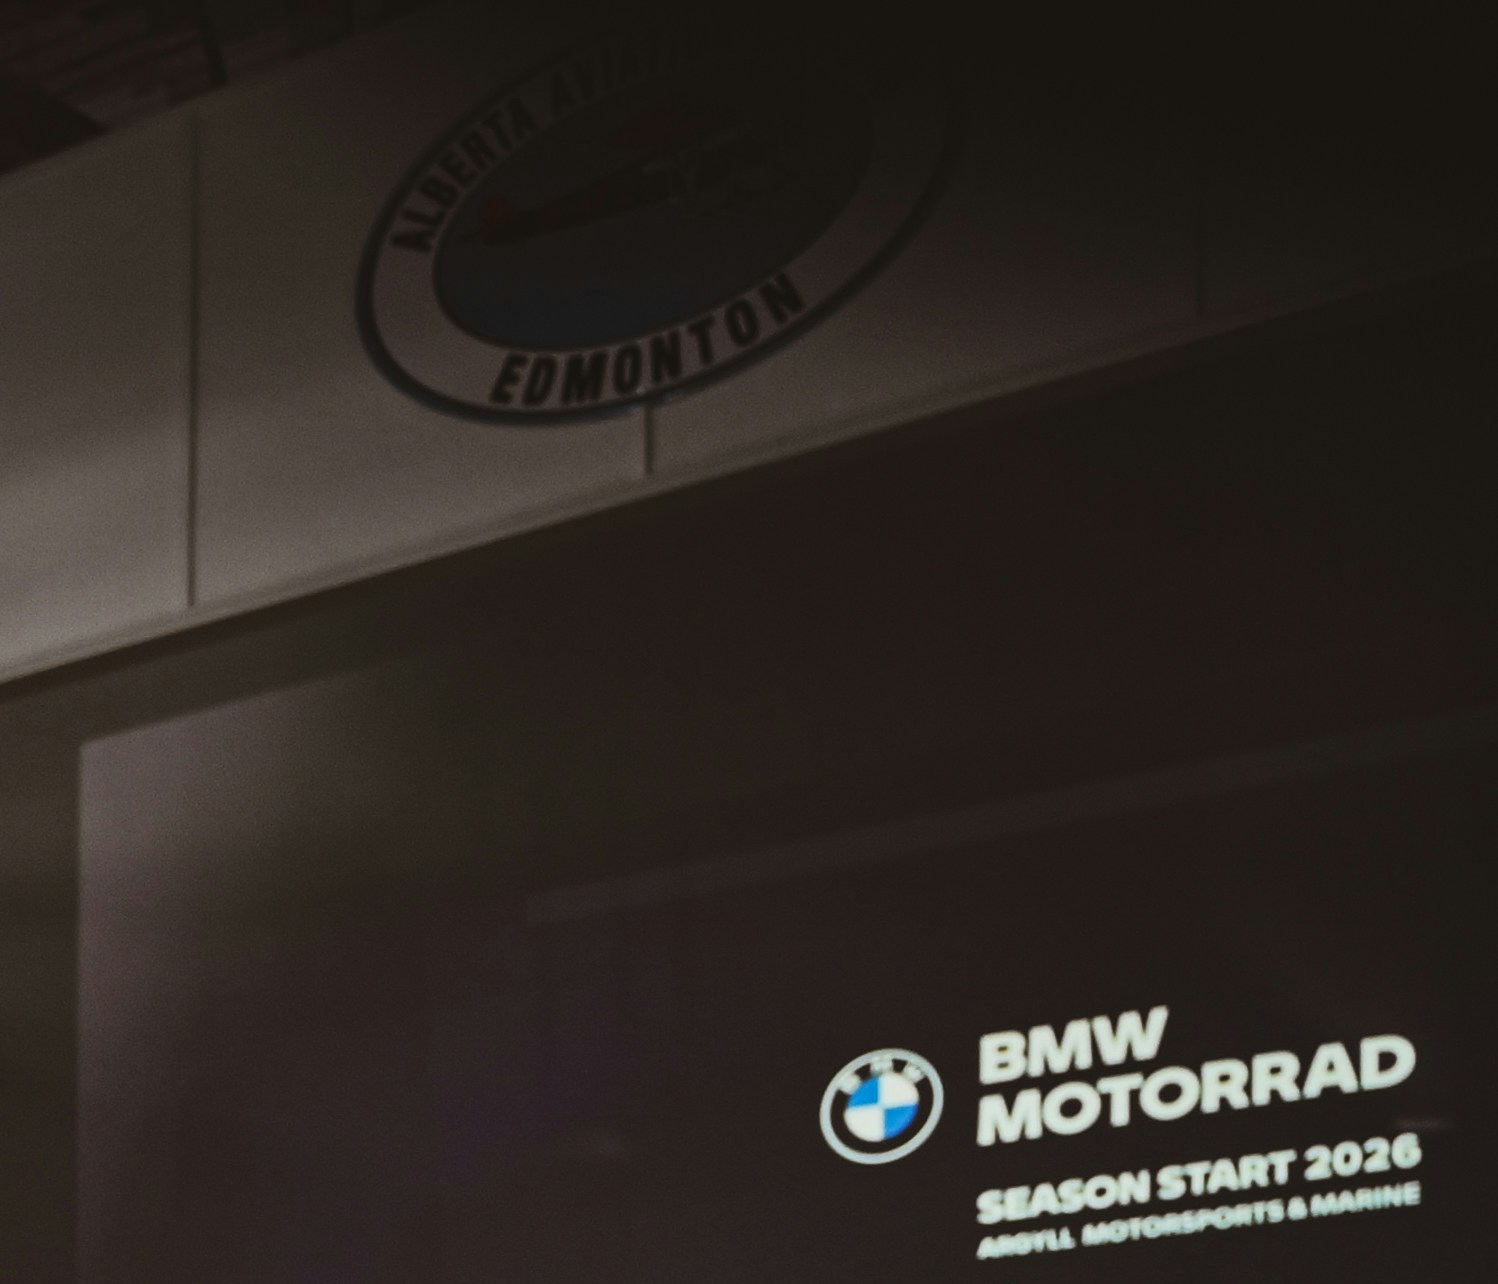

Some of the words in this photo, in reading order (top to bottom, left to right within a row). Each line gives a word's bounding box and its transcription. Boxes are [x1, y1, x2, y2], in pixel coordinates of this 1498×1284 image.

[391, 96, 537, 253] ALBERTA
[489, 273, 807, 406] EDMONTON
[977, 1034, 1417, 1147] MOTORRAD
[979, 1006, 1169, 1085] BMW
[976, 1169, 1151, 1225] SEASON
[1157, 1149, 1297, 1201] START
[1304, 1132, 1423, 1181] 2026
[976, 1226, 1077, 1260] ARGYLL
[1082, 1199, 1285, 1247] MOTORSPORTS
[1287, 1196, 1308, 1220] &
[1310, 1181, 1422, 1217] MARINE
